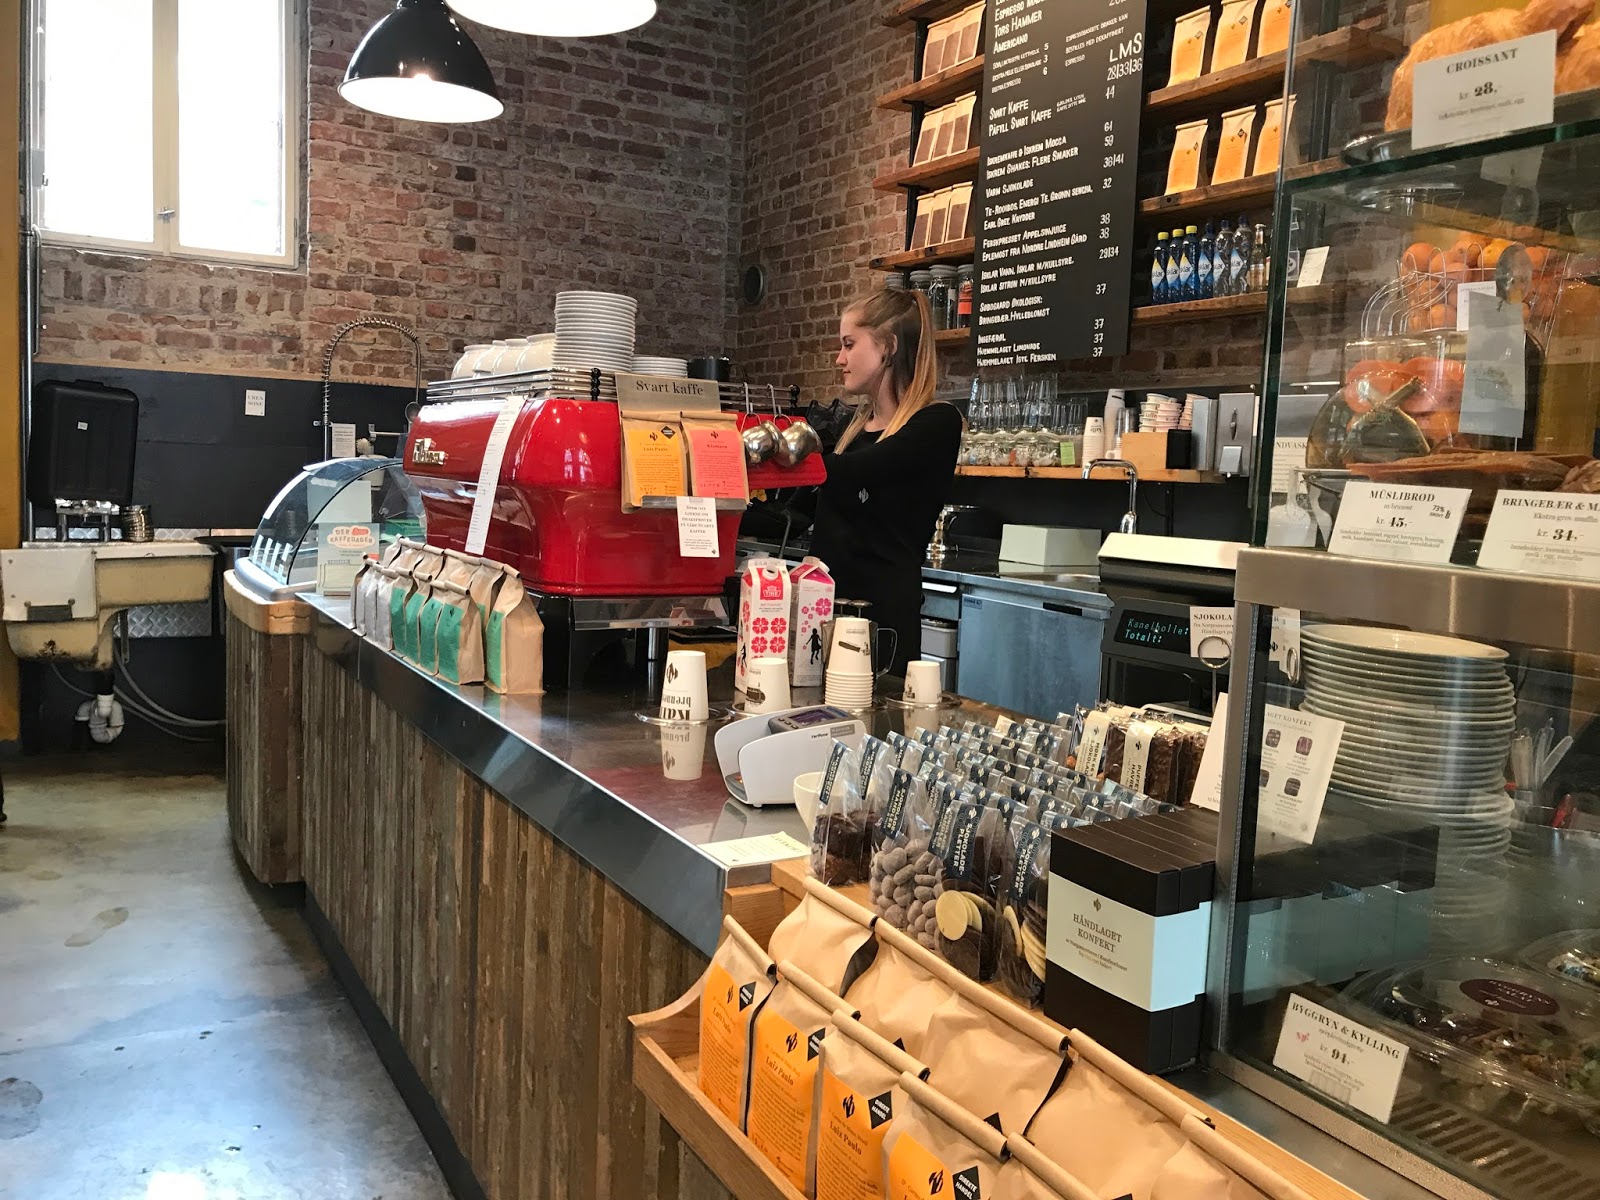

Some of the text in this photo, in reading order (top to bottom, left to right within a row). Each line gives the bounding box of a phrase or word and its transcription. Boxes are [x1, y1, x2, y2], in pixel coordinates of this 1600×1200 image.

[1446, 48, 1519, 74] CROISSANT
[1102, 177, 1112, 189] 32
[1100, 212, 1110, 224] 38
[1099, 227, 1110, 239] 38
[1096, 283, 1107, 295] 37
[1094, 318, 1104, 330] 37
[1093, 332, 1104, 344] 37
[1092, 346, 1103, 358] 37
[636, 380, 704, 396] Svart kaffe
[1276, 440, 1308, 450] NDVASK
[1574, 502, 1585, 510] &
[1125, 629, 1162, 644] Totalt:
[1084, 738, 1094, 776] SJOKOLAD
[887, 790, 900, 828] MANDLER
[953, 828, 965, 867] PLETTER
[958, 822, 972, 876] SJOKOLADE-
[1014, 848, 1026, 888] PLETTER
[1073, 913, 1122, 943] HÅNDLAGET
[1078, 928, 1116, 953] KONFEKT
[1292, 1002, 1340, 1030] BYGGRYN
[1340, 1026, 1349, 1034] &
[1350, 1030, 1400, 1059] KYLLING
[766, 1056, 778, 1072] Luiz
[778, 1068, 794, 1086] Paulo
[830, 1120, 862, 1156] Luiz Paulo
[955, 1182, 974, 1200] HANDEL
[958, 1174, 978, 1192] DIREKTE
